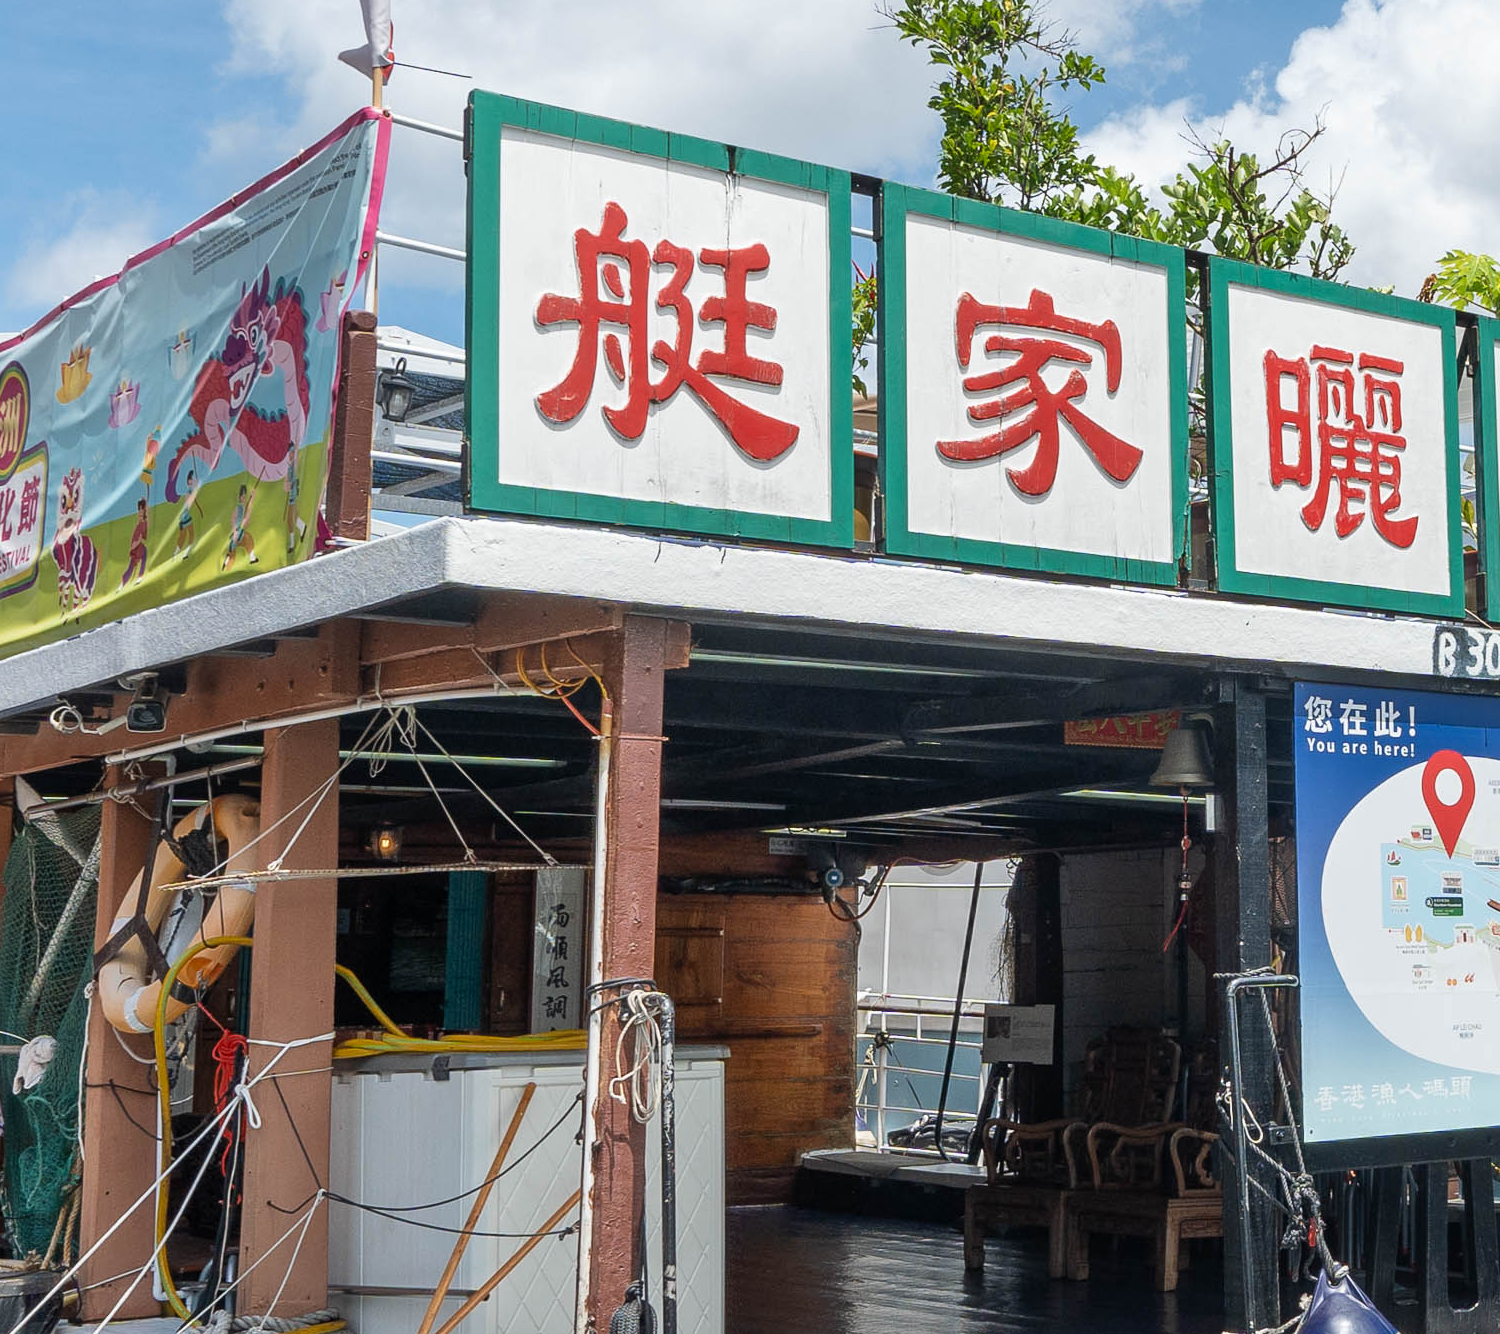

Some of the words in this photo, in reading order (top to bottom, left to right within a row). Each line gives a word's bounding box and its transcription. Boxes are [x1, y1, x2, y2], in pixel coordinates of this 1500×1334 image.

[1306, 737, 1336, 753] You
[1342, 742, 1368, 755] are
[1374, 740, 1416, 758] here!
[541, 903, 570, 1032] 雨順風調
[1313, 1074, 1474, 1112] 香港漁人碼頭
